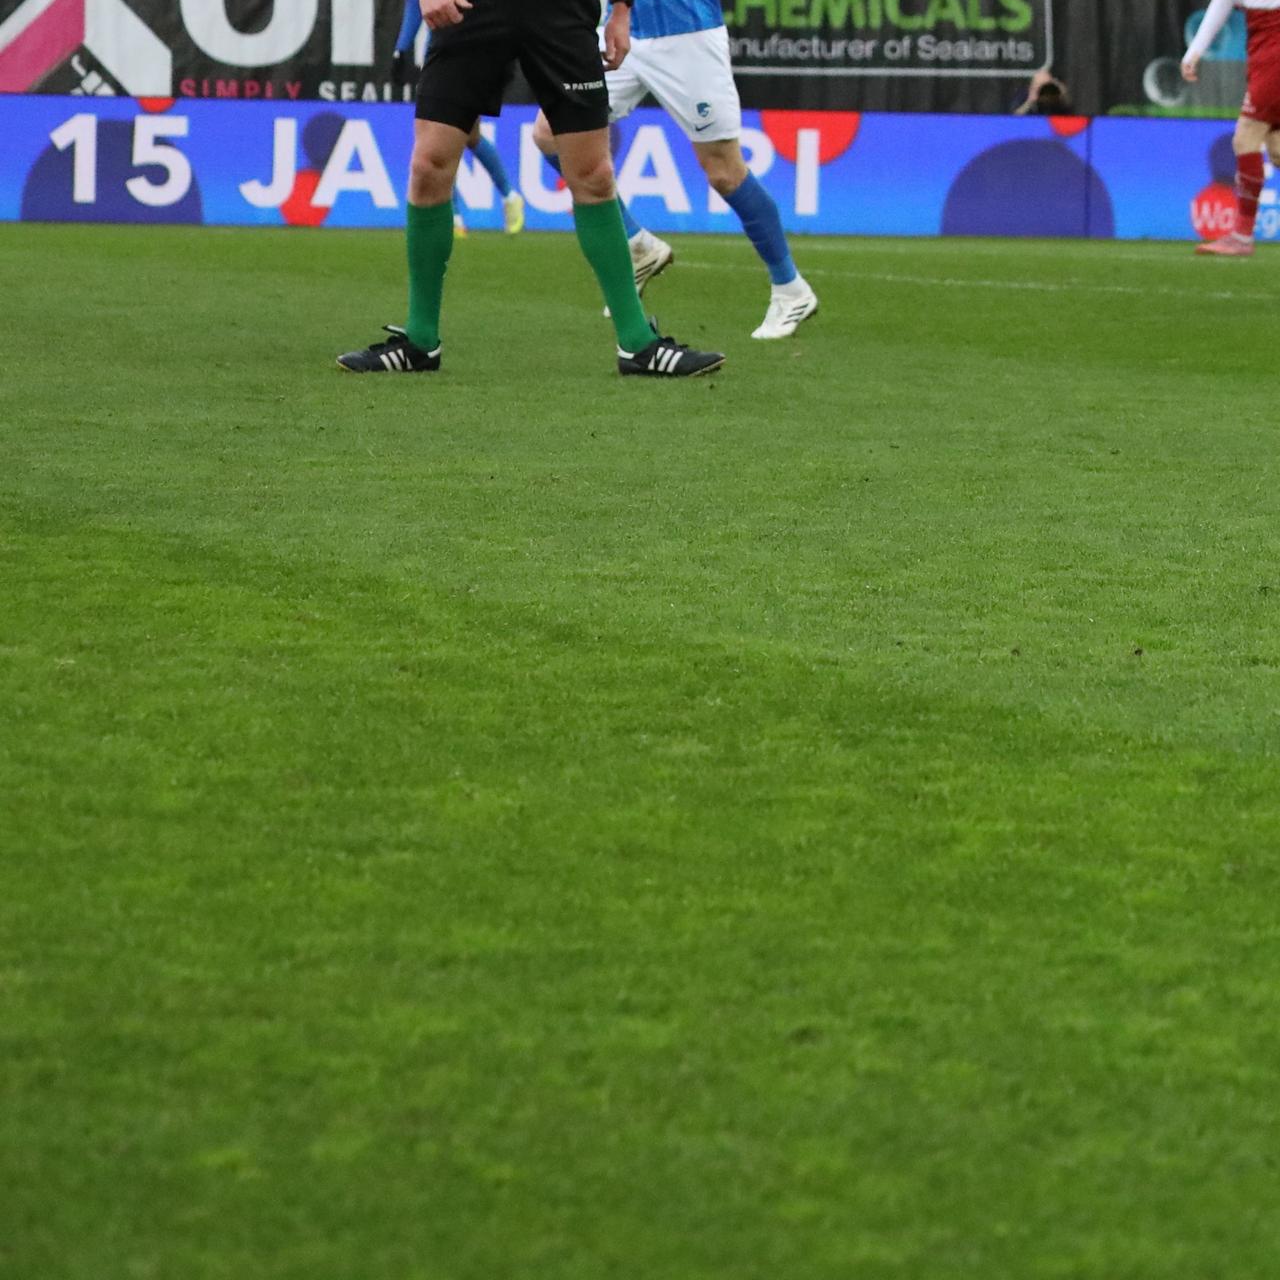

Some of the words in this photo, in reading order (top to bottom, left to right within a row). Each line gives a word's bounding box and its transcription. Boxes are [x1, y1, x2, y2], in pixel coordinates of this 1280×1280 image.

[884, 34, 912, 59] of
[917, 34, 1034, 63] Sealants
[180, 78, 303, 100] SIMPLY
[49, 113, 194, 207] 15
